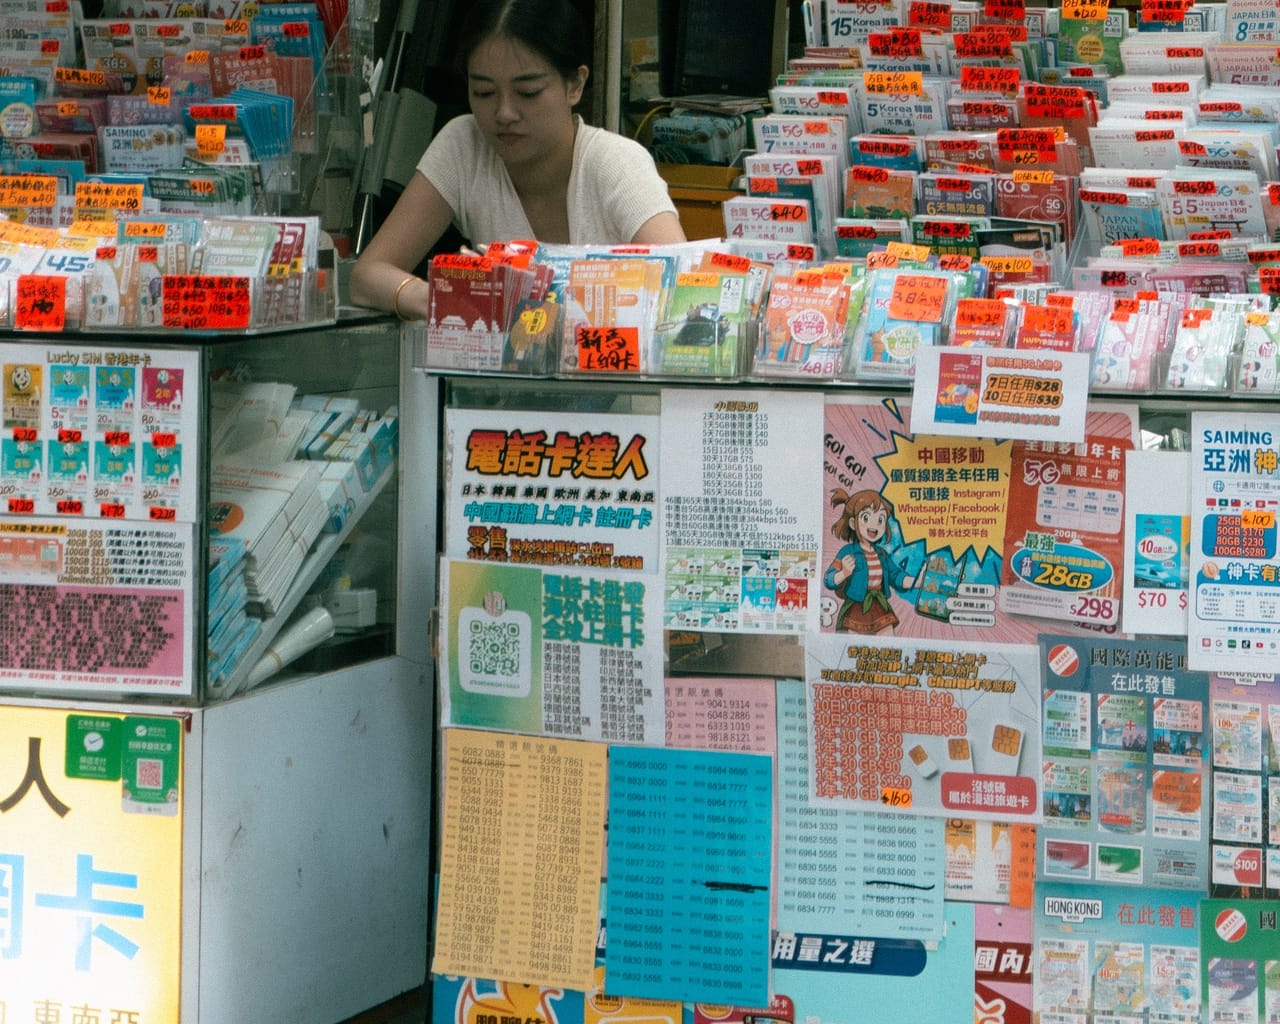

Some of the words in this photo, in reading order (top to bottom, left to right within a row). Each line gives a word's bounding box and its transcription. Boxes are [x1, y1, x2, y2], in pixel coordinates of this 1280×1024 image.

[831, 17, 853, 35] 15
[853, 17, 882, 27] Korea
[47, 351, 80, 364] Lucky
[82, 351, 102, 364] SIM
[988, 377, 1061, 392] 7日任用$28
[984, 391, 1061, 407] 10日任用$38
[1203, 429, 1273, 446] SAIMING
[466, 429, 649, 480] 電話卡達人
[917, 447, 985, 464] 中國移動
[908, 487, 950, 501] 可連接
[953, 488, 1001, 499] Instagram
[595, 505, 653, 529] 註冊卡
[898, 503, 948, 515] Whatsapp
[952, 503, 1000, 514] Facebook
[906, 516, 945, 526] Wechat
[950, 516, 997, 528] Telegram
[1217, 536, 1241, 547] 80GB
[1243, 536, 1265, 548] $230
[1035, 563, 1093, 589] 28GB
[1070, 597, 1113, 619] $298
[1138, 592, 1167, 608] $70
[1111, 673, 1177, 695] 在此發售
[707, 698, 728, 709] 9041
[729, 700, 750, 710] 9314
[930, 692, 955, 706] $40
[1233, 858, 1258, 872] $100
[1047, 899, 1073, 915] HONG
[1074, 902, 1100, 916] KONG
[1118, 903, 1195, 928] 在此發售
[772, 939, 875, 966] 用量之選
